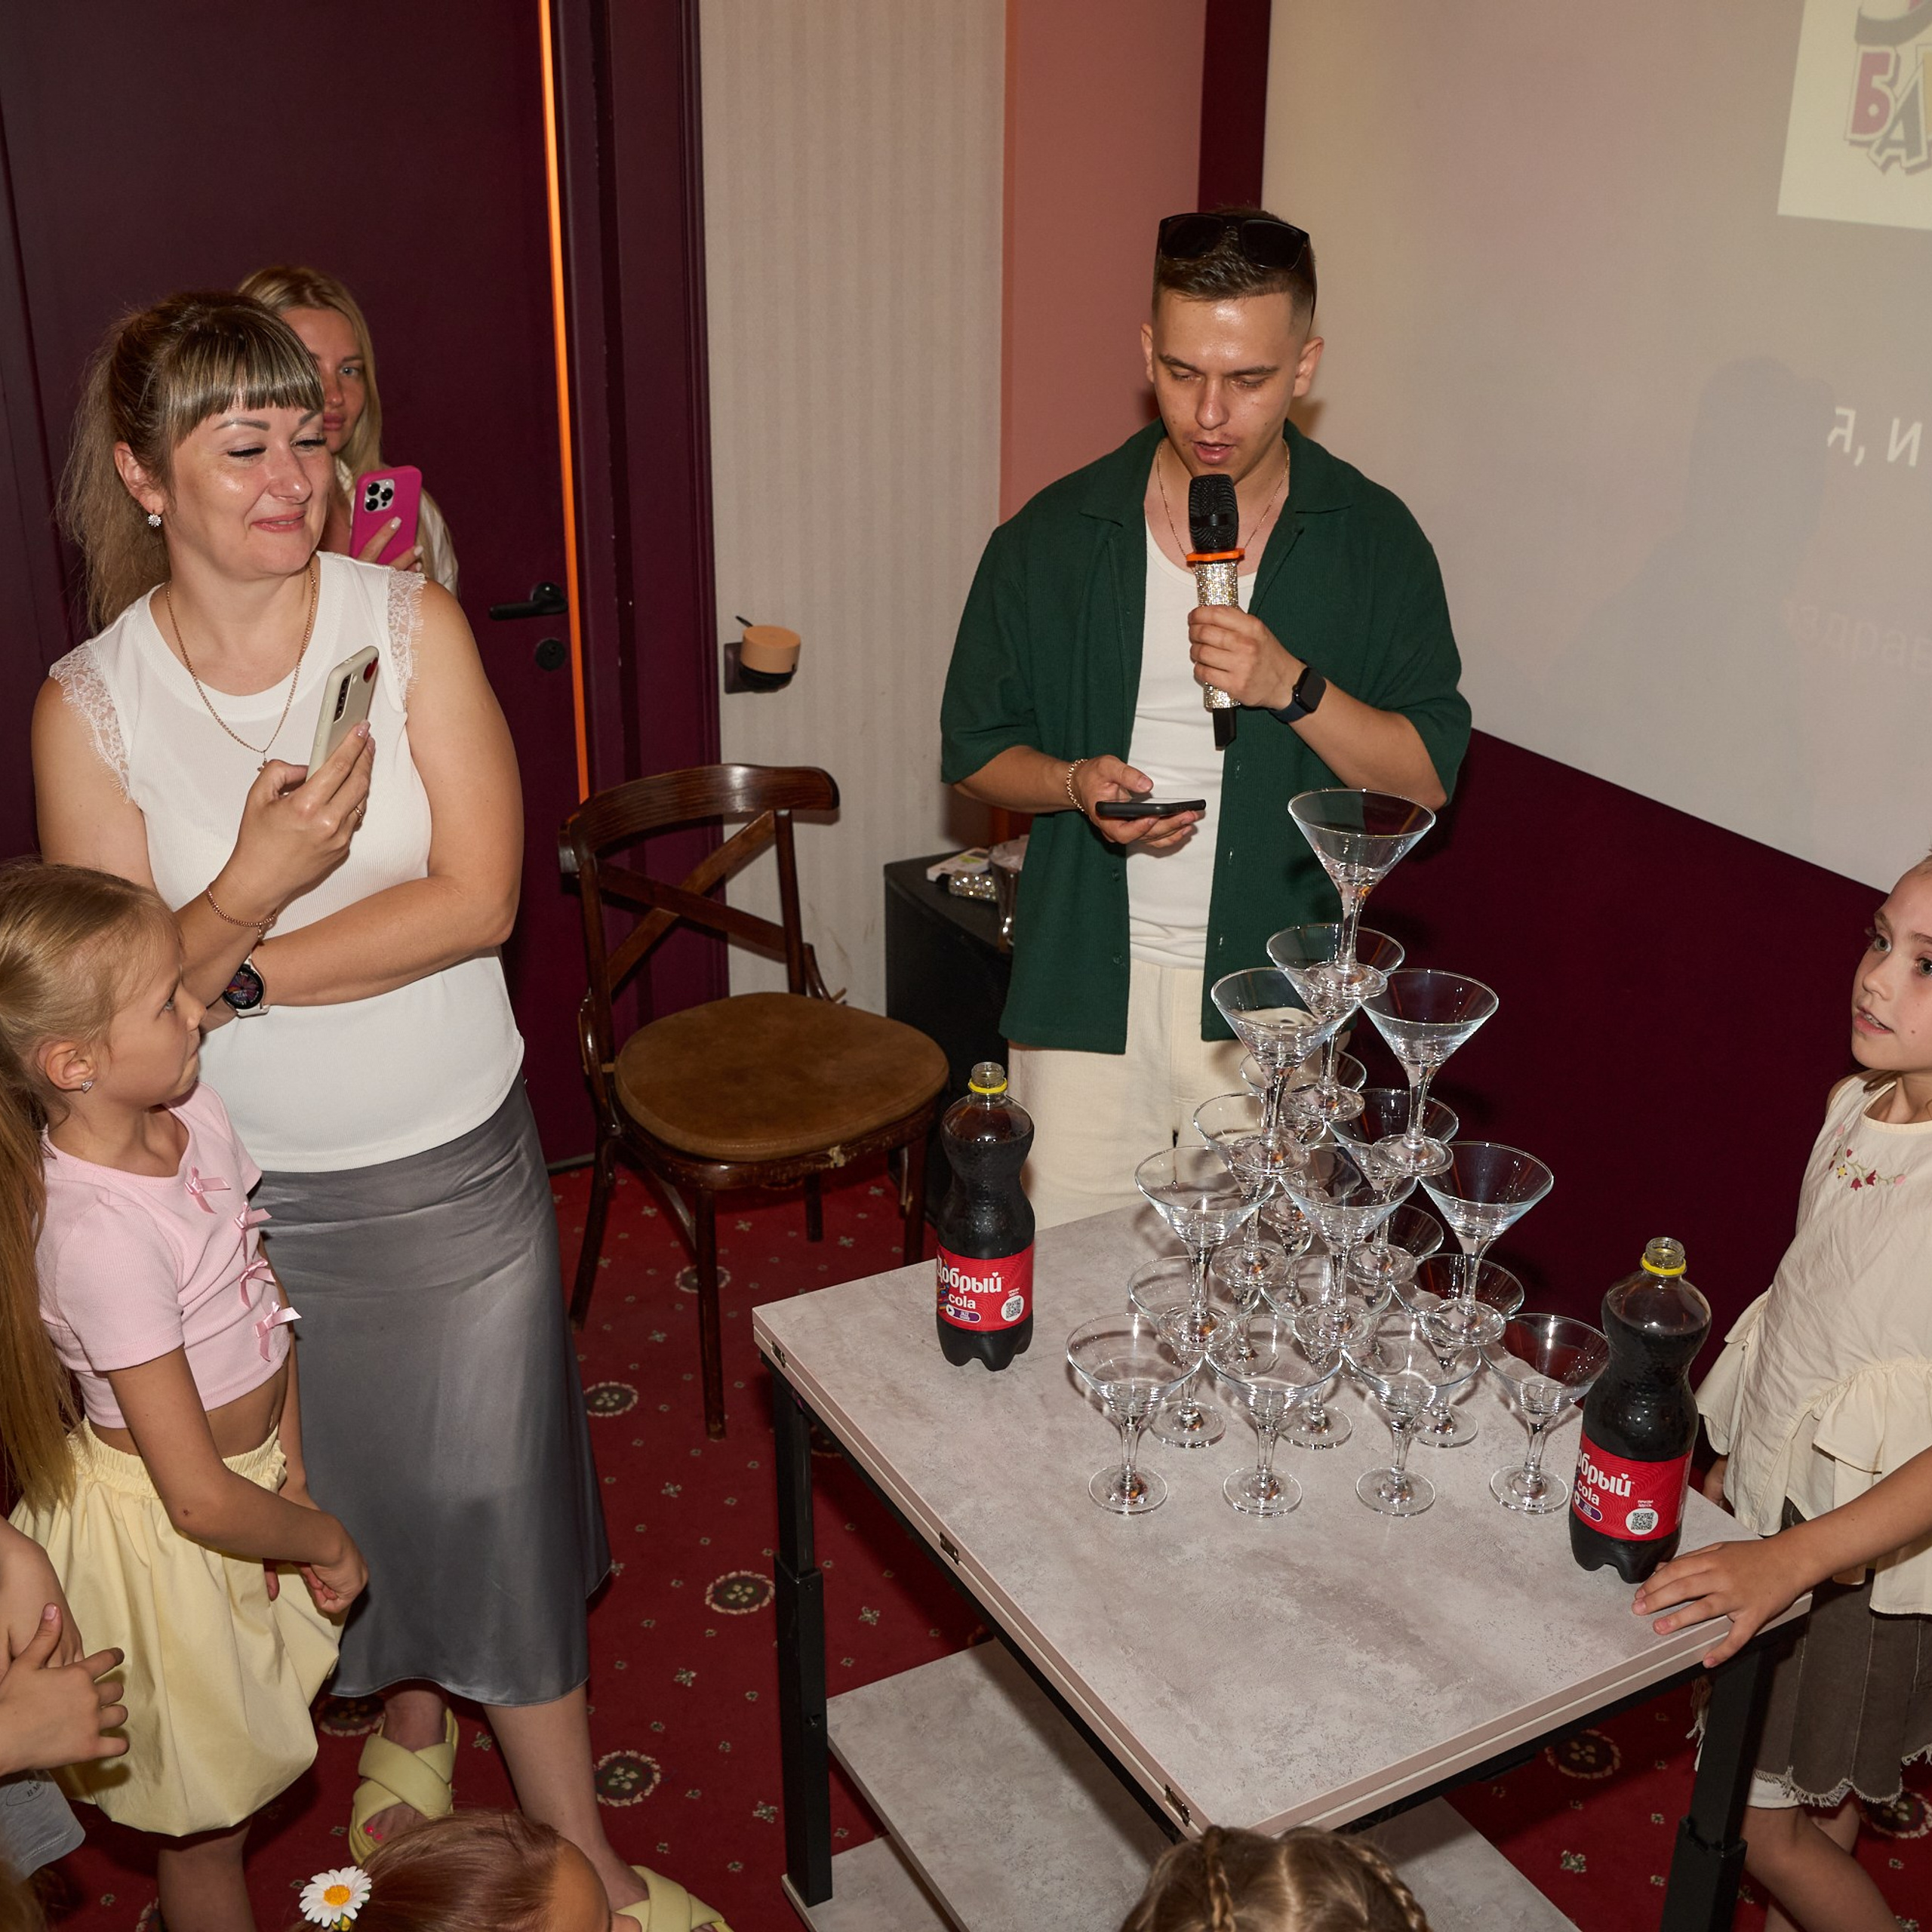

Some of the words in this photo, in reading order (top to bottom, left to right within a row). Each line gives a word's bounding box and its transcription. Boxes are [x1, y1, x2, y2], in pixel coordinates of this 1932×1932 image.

[1844, 45, 1932, 175] БА
[948, 1294, 976, 1309] cola
[1577, 1447, 1632, 1497] обрый
[1577, 1479, 1600, 1506] cola
